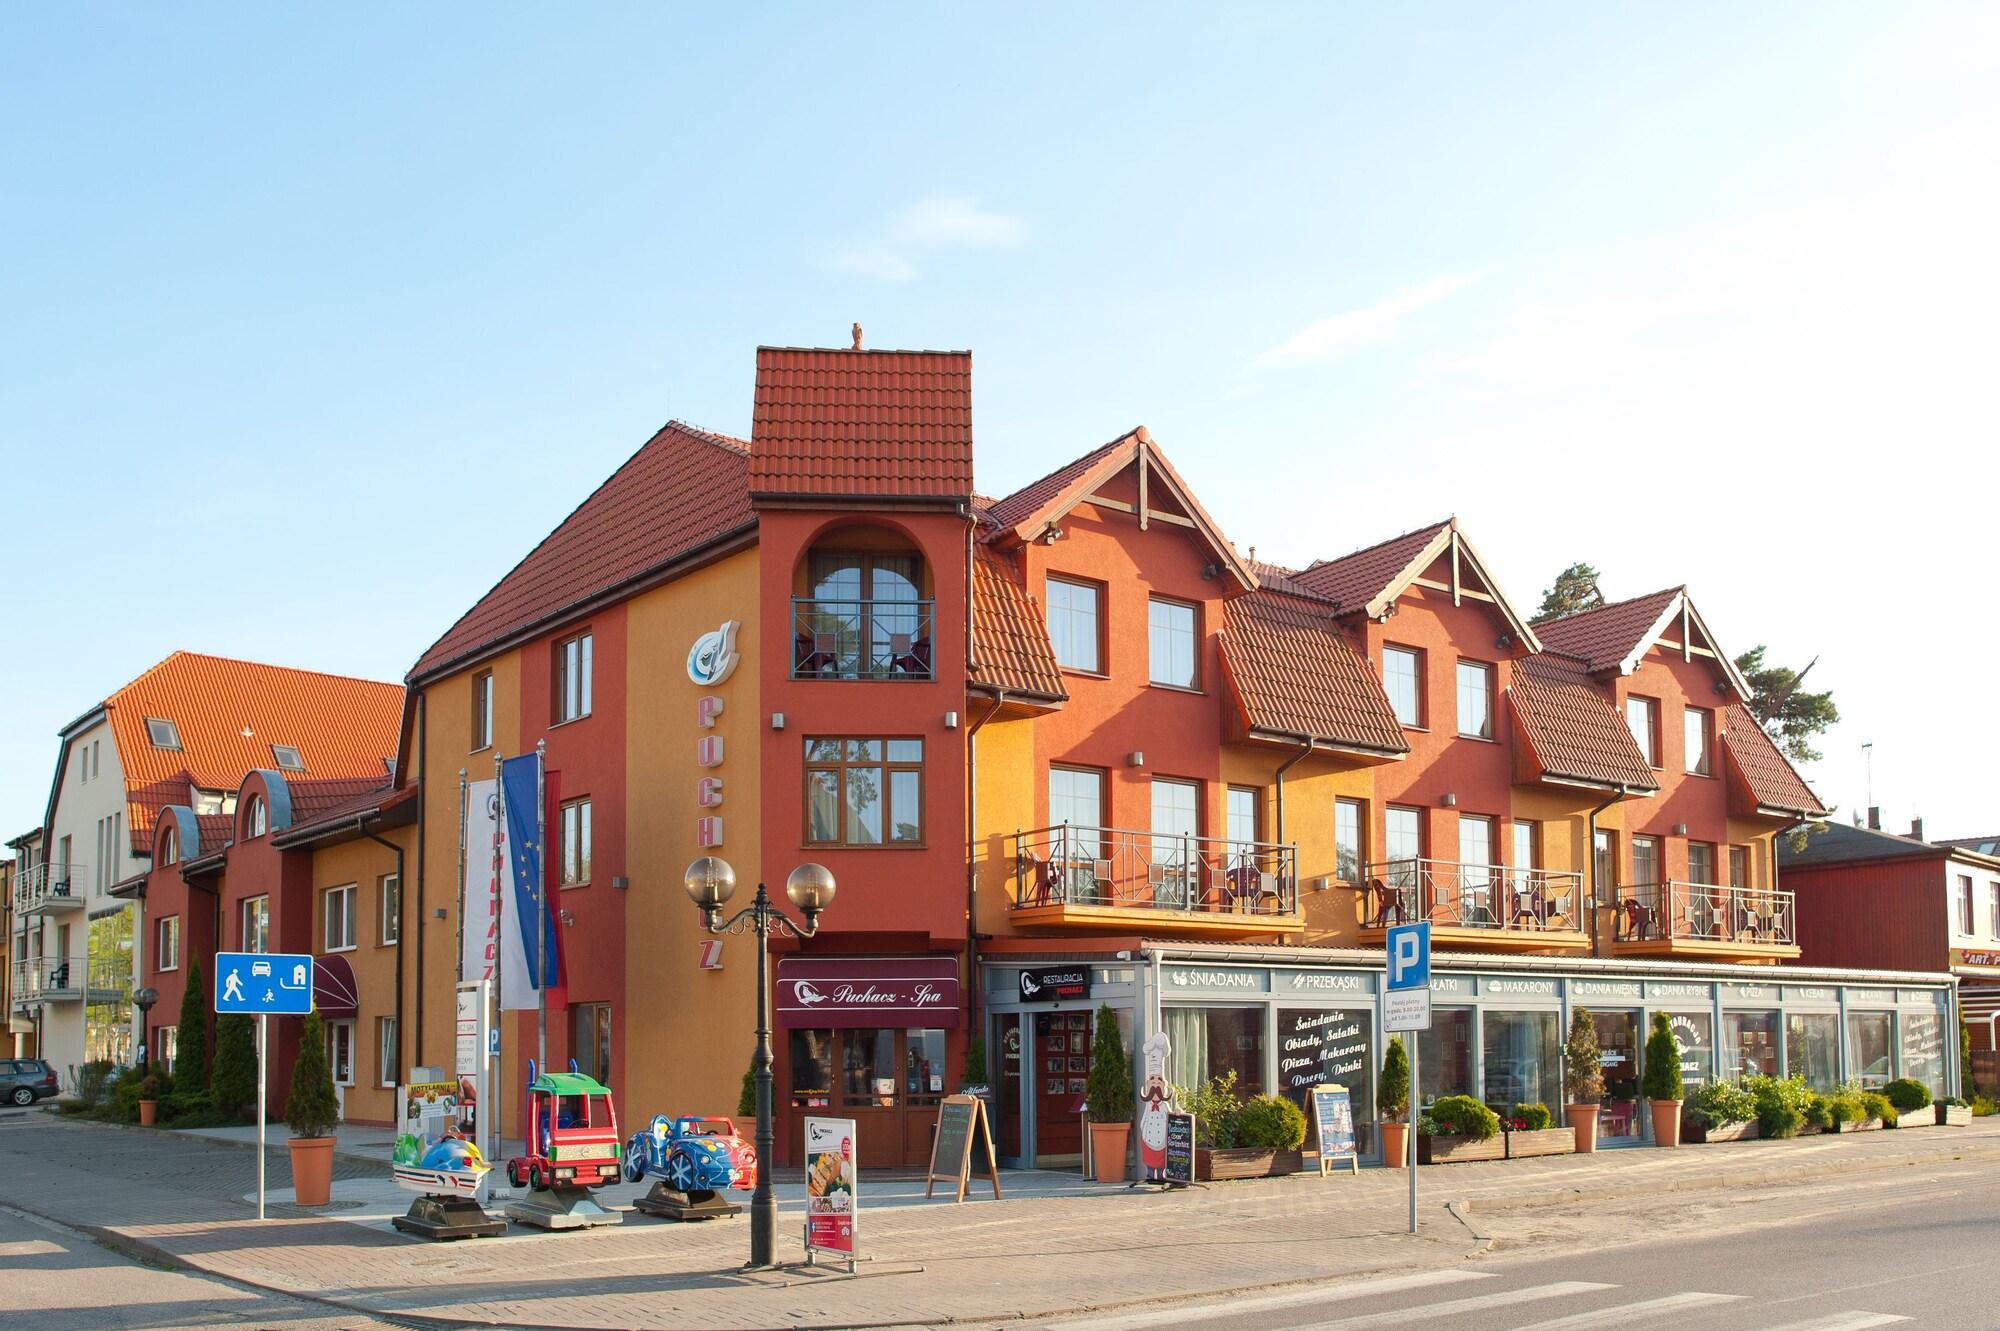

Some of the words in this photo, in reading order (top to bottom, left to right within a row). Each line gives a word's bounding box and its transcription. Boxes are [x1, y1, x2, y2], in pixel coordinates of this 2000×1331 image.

[697, 695, 724, 970] PUCHCZ
[1395, 931, 1420, 982] P
[1968, 954, 1990, 965] ART.
[1043, 973, 1083, 985] RESTAURACJA
[1190, 969, 1255, 987] ŚNIADANIA
[1306, 974, 1359, 991] PRZEKĄSKI
[1429, 978, 1457, 991] AŁATKI
[1503, 981, 1553, 993] MAKARONY
[832, 984, 896, 1003] Puchacz
[910, 983, 942, 1007] Spa
[1585, 982, 1611, 994] DANIA
[1662, 984, 1685, 996] DANIA
[1295, 1011, 1344, 1031] Śniadania
[1669, 1015, 1701, 1045] TAURACJA
[490, 1029, 499, 1051] P
[1285, 1034, 1323, 1051] Obiady,
[1281, 1057, 1313, 1072] Pizza,
[1317, 1043, 1366, 1062] Makarony
[1291, 1072, 1327, 1087] Desery,
[1331, 1058, 1362, 1076] Drinki
